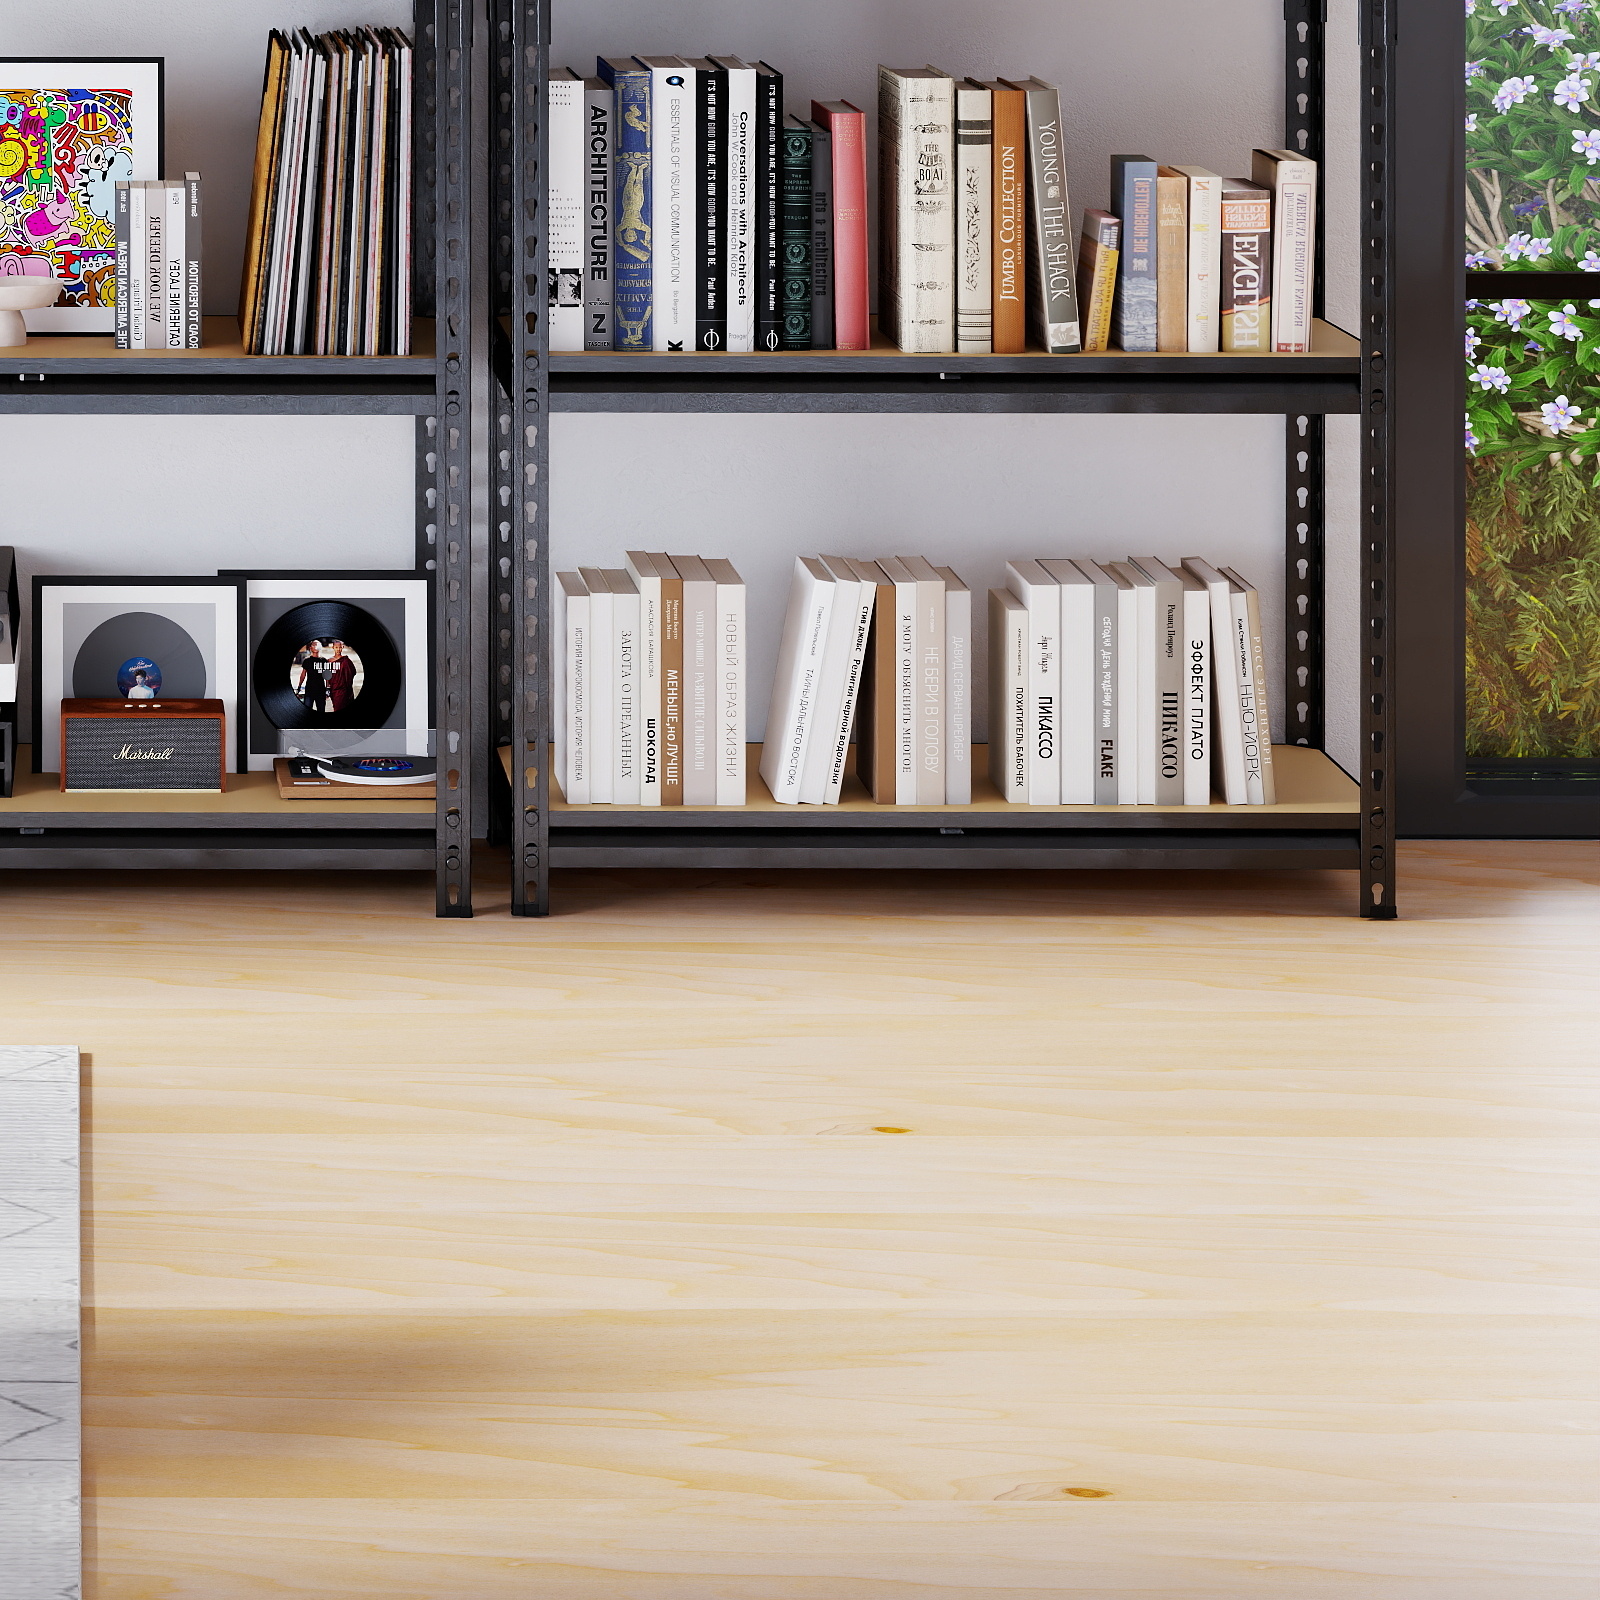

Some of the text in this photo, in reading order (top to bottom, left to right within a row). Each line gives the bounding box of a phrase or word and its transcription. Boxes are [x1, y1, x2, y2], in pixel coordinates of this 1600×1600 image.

[920, 168, 944, 181] BOAT
[1038, 120, 1060, 184] YOUNG
[589, 104, 608, 282] ARCHITECTURE
[670, 98, 680, 283] ESSENTIALS OF VISUAL COMMUNICATION
[738, 111, 748, 306] Conversations with Architects
[1000, 146, 1019, 301] JUMBO COLLECTION
[1043, 202, 1070, 301] THE SHACK
[903, 625, 912, 654] МОГУ
[1165, 604, 1176, 658] Роланд Пенроуз
[620, 630, 631, 778] ЗАБОТА О ПРЕДАННЫХ
[725, 613, 739, 777] НОВЫЙ ОБРАЗ ЖИЗНИ
[846, 659, 860, 697] Религия
[902, 659, 911, 724] ОБЪЯСНИТЬ
[1100, 616, 1112, 728] СЕГОДНЯ ДЕНЬ РОЖДЕНИЯ МИРА
[1190, 640, 1204, 760] ЭФФЕКТ ПЛАТО
[842, 699, 856, 732] черной
[924, 647, 939, 774] НЕ БЕРИ В ГОЛОВУ
[1015, 687, 1023, 745] ПОХИТИТЕЛЬ
[1038, 696, 1052, 759] ПИКАССО
[1161, 692, 1178, 779] ПИКАССО
[1239, 684, 1261, 781] НЬЮ-ЙОРК
[113, 744, 174, 760] Marshall
[645, 718, 656, 784] ШОКОЛАД
[666, 742, 678, 785] ЛУЧШЕ
[832, 735, 848, 784] водолазки
[902, 728, 911, 773] МНОГОЕ
[1100, 739, 1113, 778] FLAKE
